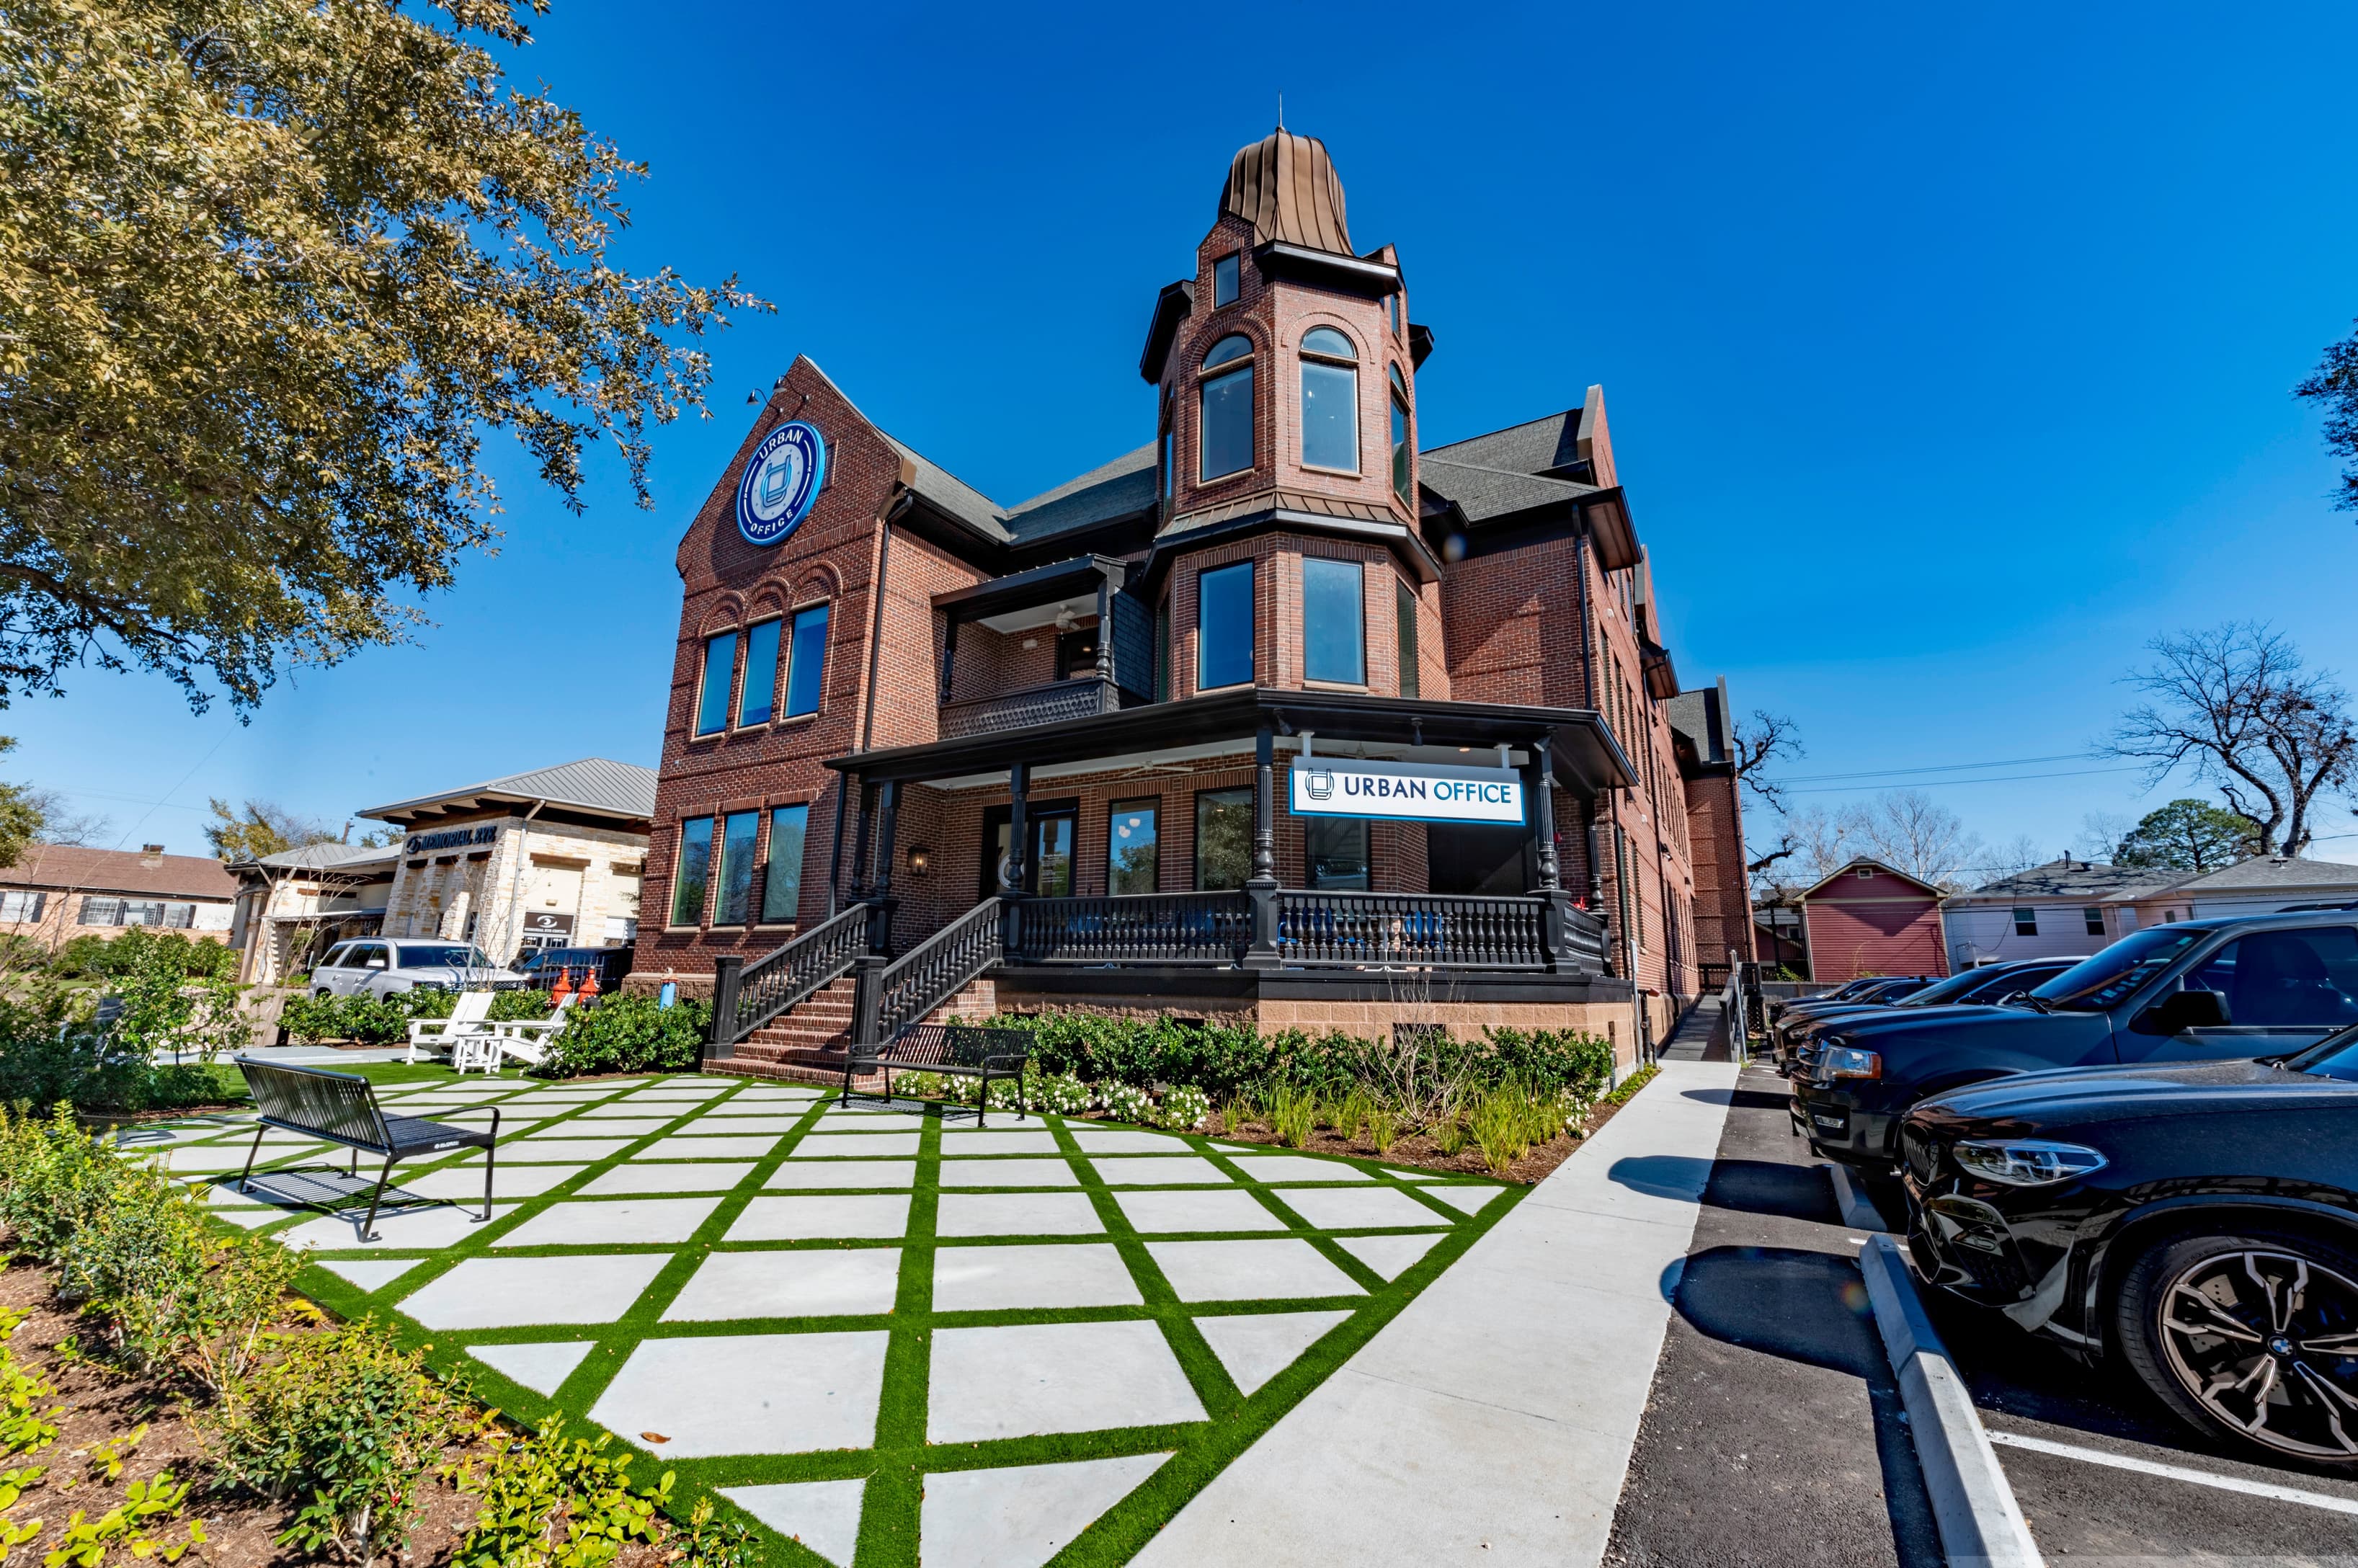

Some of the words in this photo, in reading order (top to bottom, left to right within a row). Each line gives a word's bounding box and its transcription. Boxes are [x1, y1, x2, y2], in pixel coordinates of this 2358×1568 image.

[759, 429, 804, 460] URBAN
[750, 509, 793, 535] OFFICE
[1344, 777, 1426, 799] URBAN
[1433, 781, 1511, 803] OFFICE
[422, 829, 472, 850] MEMORIAL
[473, 826, 497, 844] EYE
